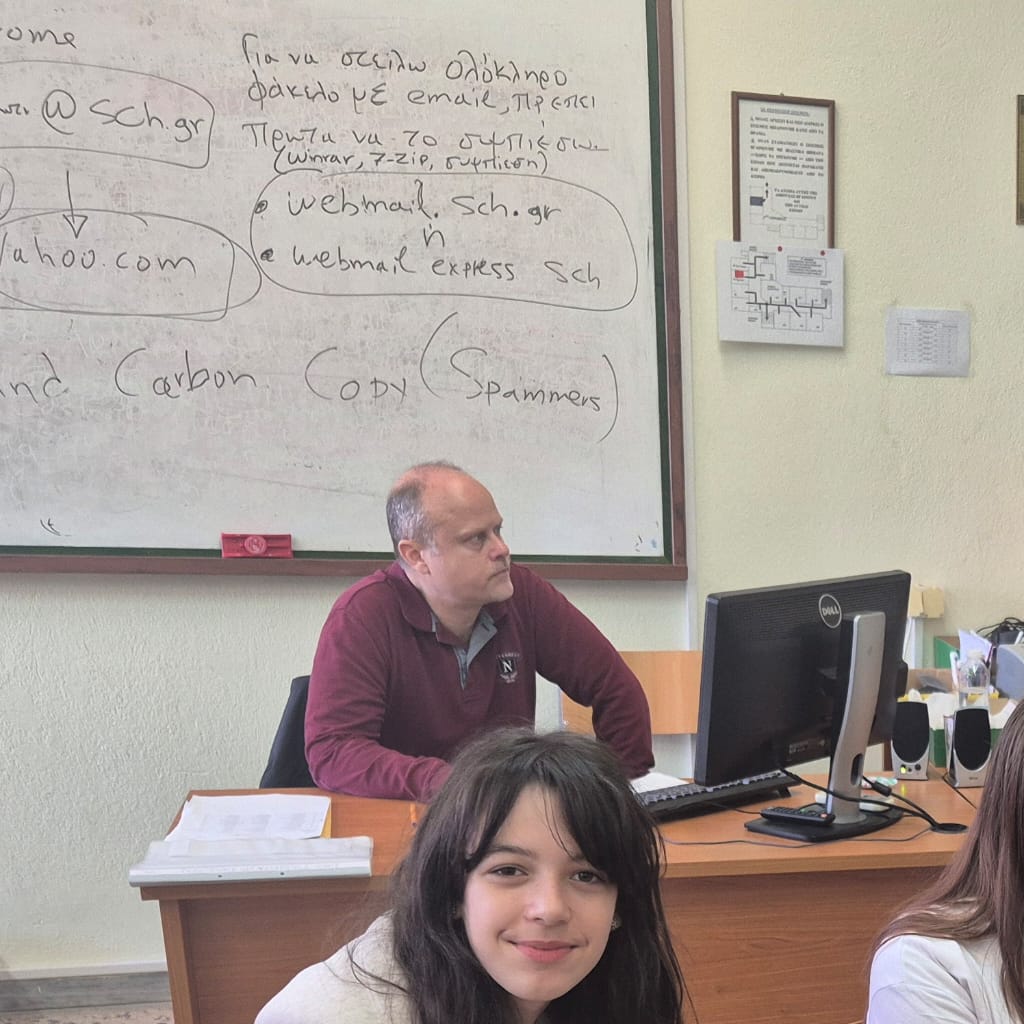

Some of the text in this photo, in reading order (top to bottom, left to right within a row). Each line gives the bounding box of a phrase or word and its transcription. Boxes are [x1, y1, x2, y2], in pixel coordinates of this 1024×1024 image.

[0, 26, 78, 49] ome
[431, 258, 516, 284] express
[0, 351, 70, 404] nd
[114, 347, 258, 398] Carbon
[821, 606, 840, 617] DELL
